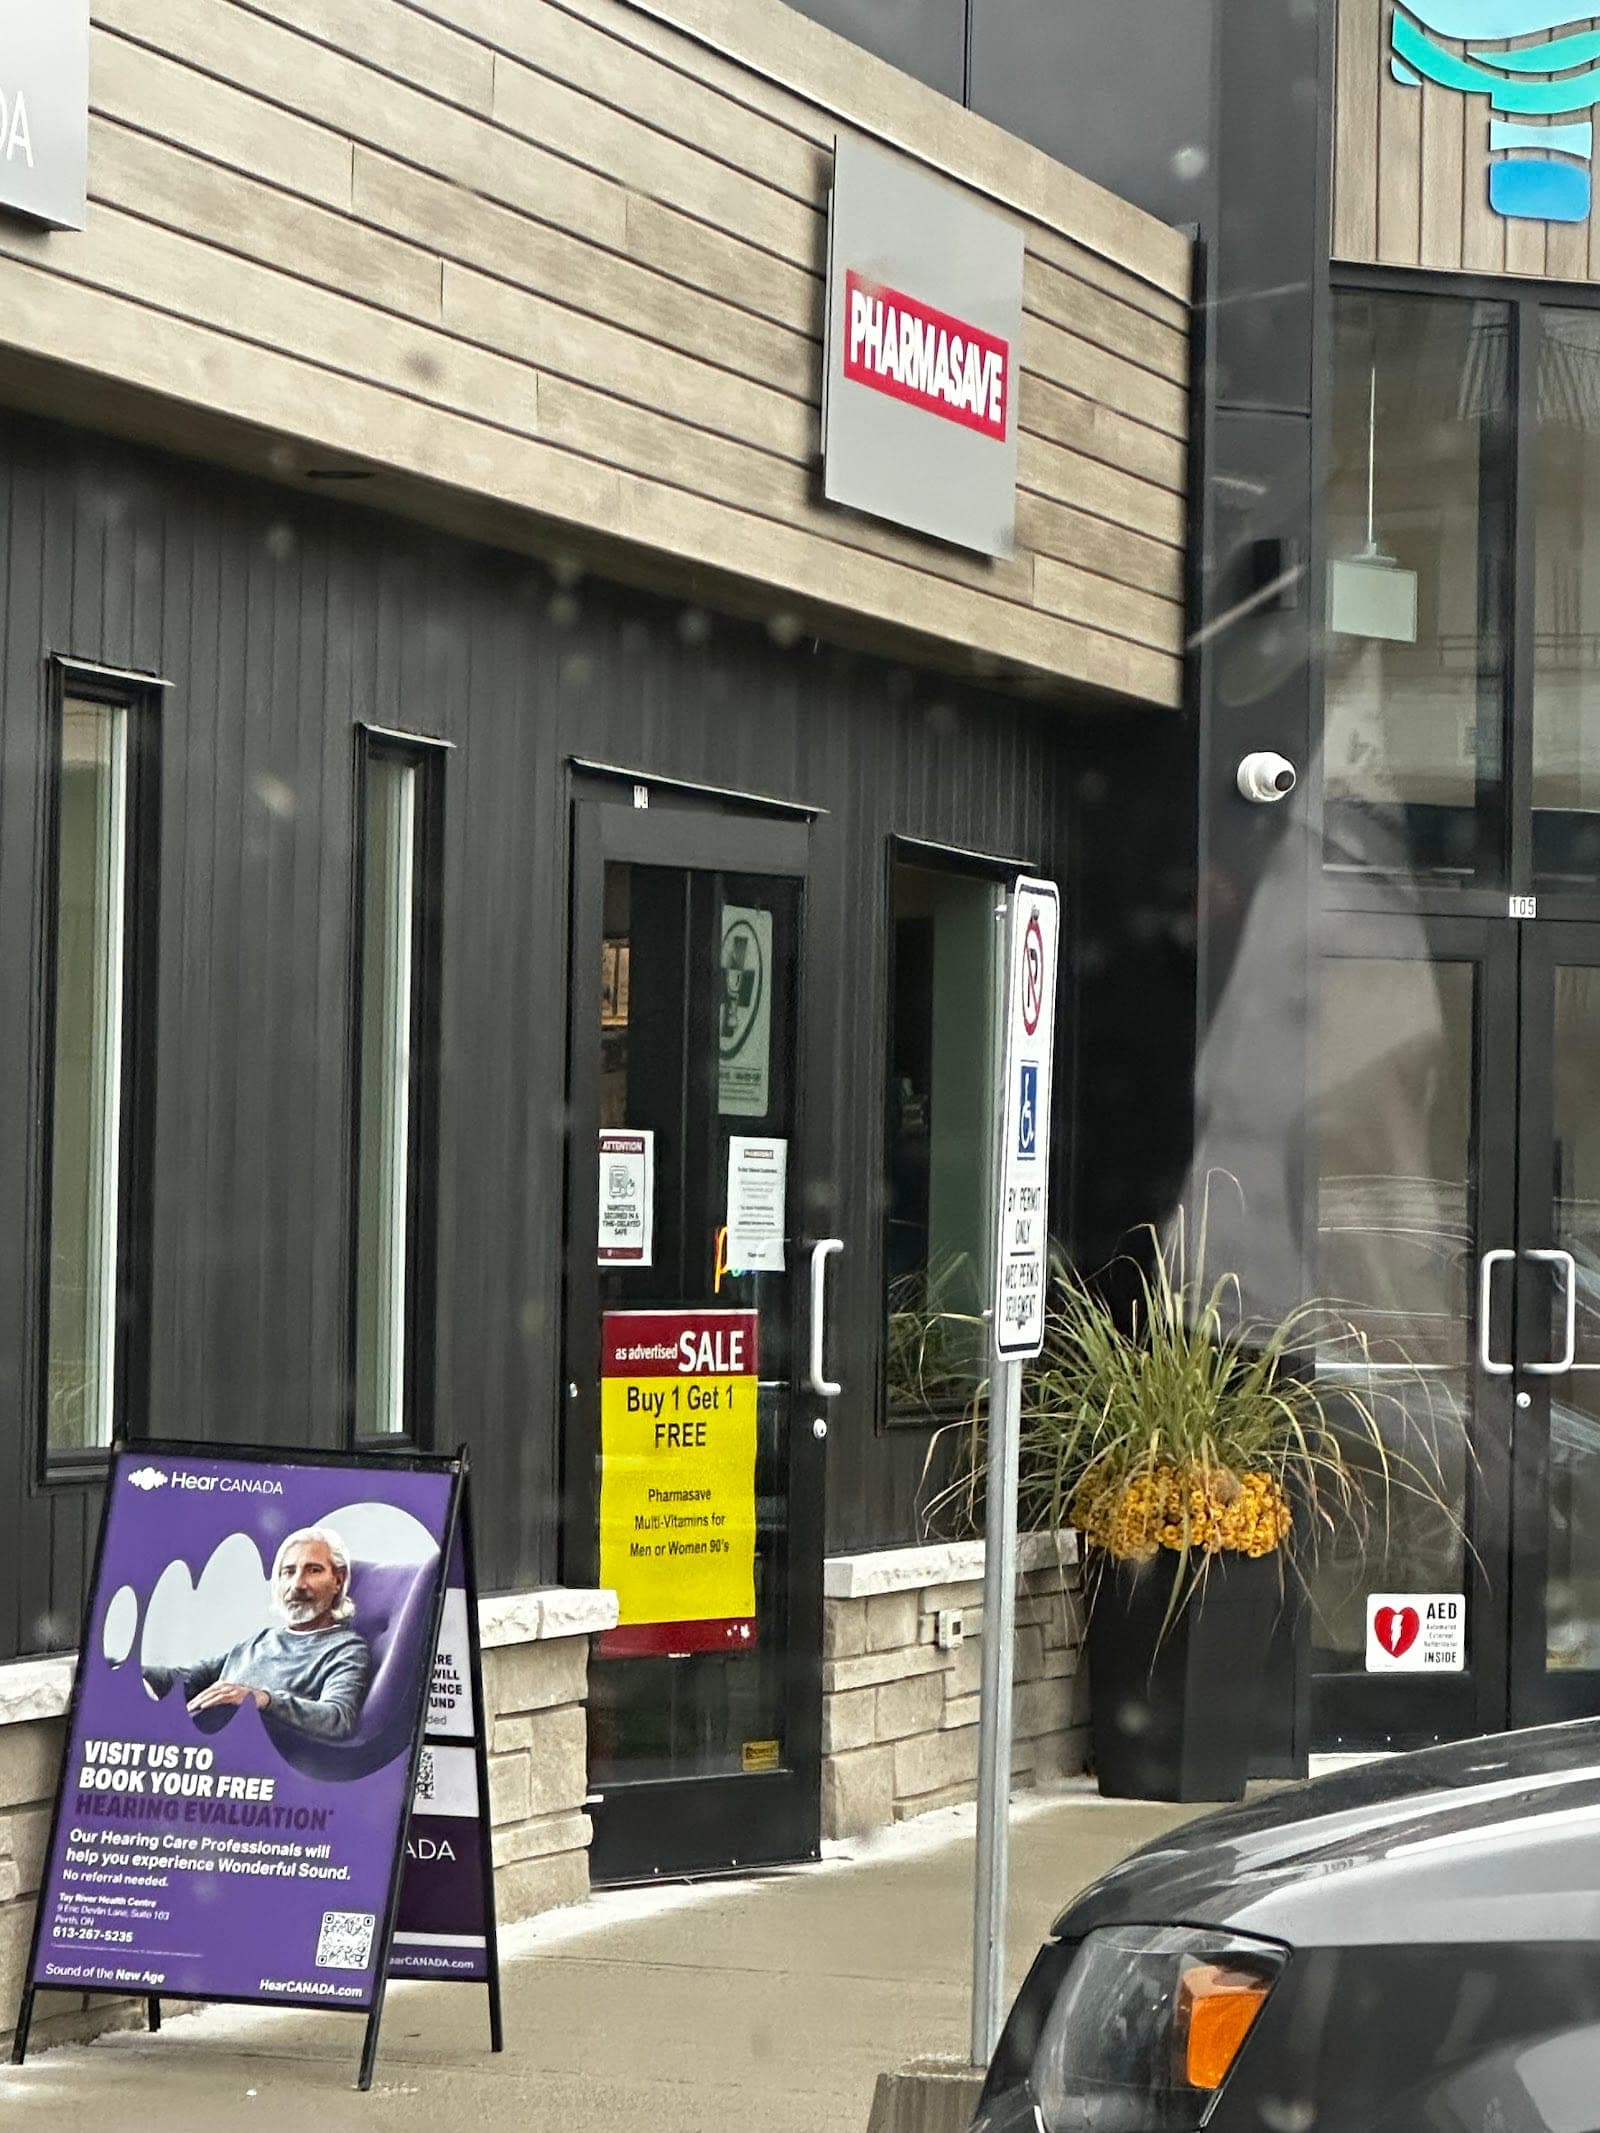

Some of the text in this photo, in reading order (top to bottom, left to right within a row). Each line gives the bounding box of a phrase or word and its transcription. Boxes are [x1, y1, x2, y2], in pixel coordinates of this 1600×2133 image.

[850, 288, 1003, 424] PHARMASAVE
[1512, 898, 1535, 916] 105
[602, 1140, 643, 1151] ATTENTION
[615, 1330, 744, 1372] as advertised SALE
[627, 1384, 734, 1418] Buy 1 Get 1
[655, 1422, 707, 1449] FREE
[648, 1488, 712, 1502] Pharmasave
[634, 1512, 726, 1530] Multi-Vitamins for
[630, 1539, 729, 1557] Men or Women 90's
[1426, 1602, 1457, 1619] AED
[434, 1654, 453, 1665] RE
[1424, 1651, 1457, 1663] INSIDE
[430, 1697, 456, 1709] UND
[84, 1740, 214, 1770] VISIT US TO
[79, 1767, 275, 1801] BOOK YOUR FREE
[74, 1794, 179, 1822] HEARING
[70, 1828, 331, 1859] Our Hearing Care Professionals will
[66, 1847, 351, 1881] help you experience Wonderful Sound.
[63, 1869, 169, 1887] No referral needed.
[59, 1892, 157, 1908] Tay River Health Centre
[80, 1916, 94, 1926] ON
[130, 1909, 152, 1919] Suite
[53, 1926, 134, 1942] 613-267-5235
[45, 1963, 165, 1985] Sound of the New Age
[259, 1979, 363, 1998] HearCANADA.com
